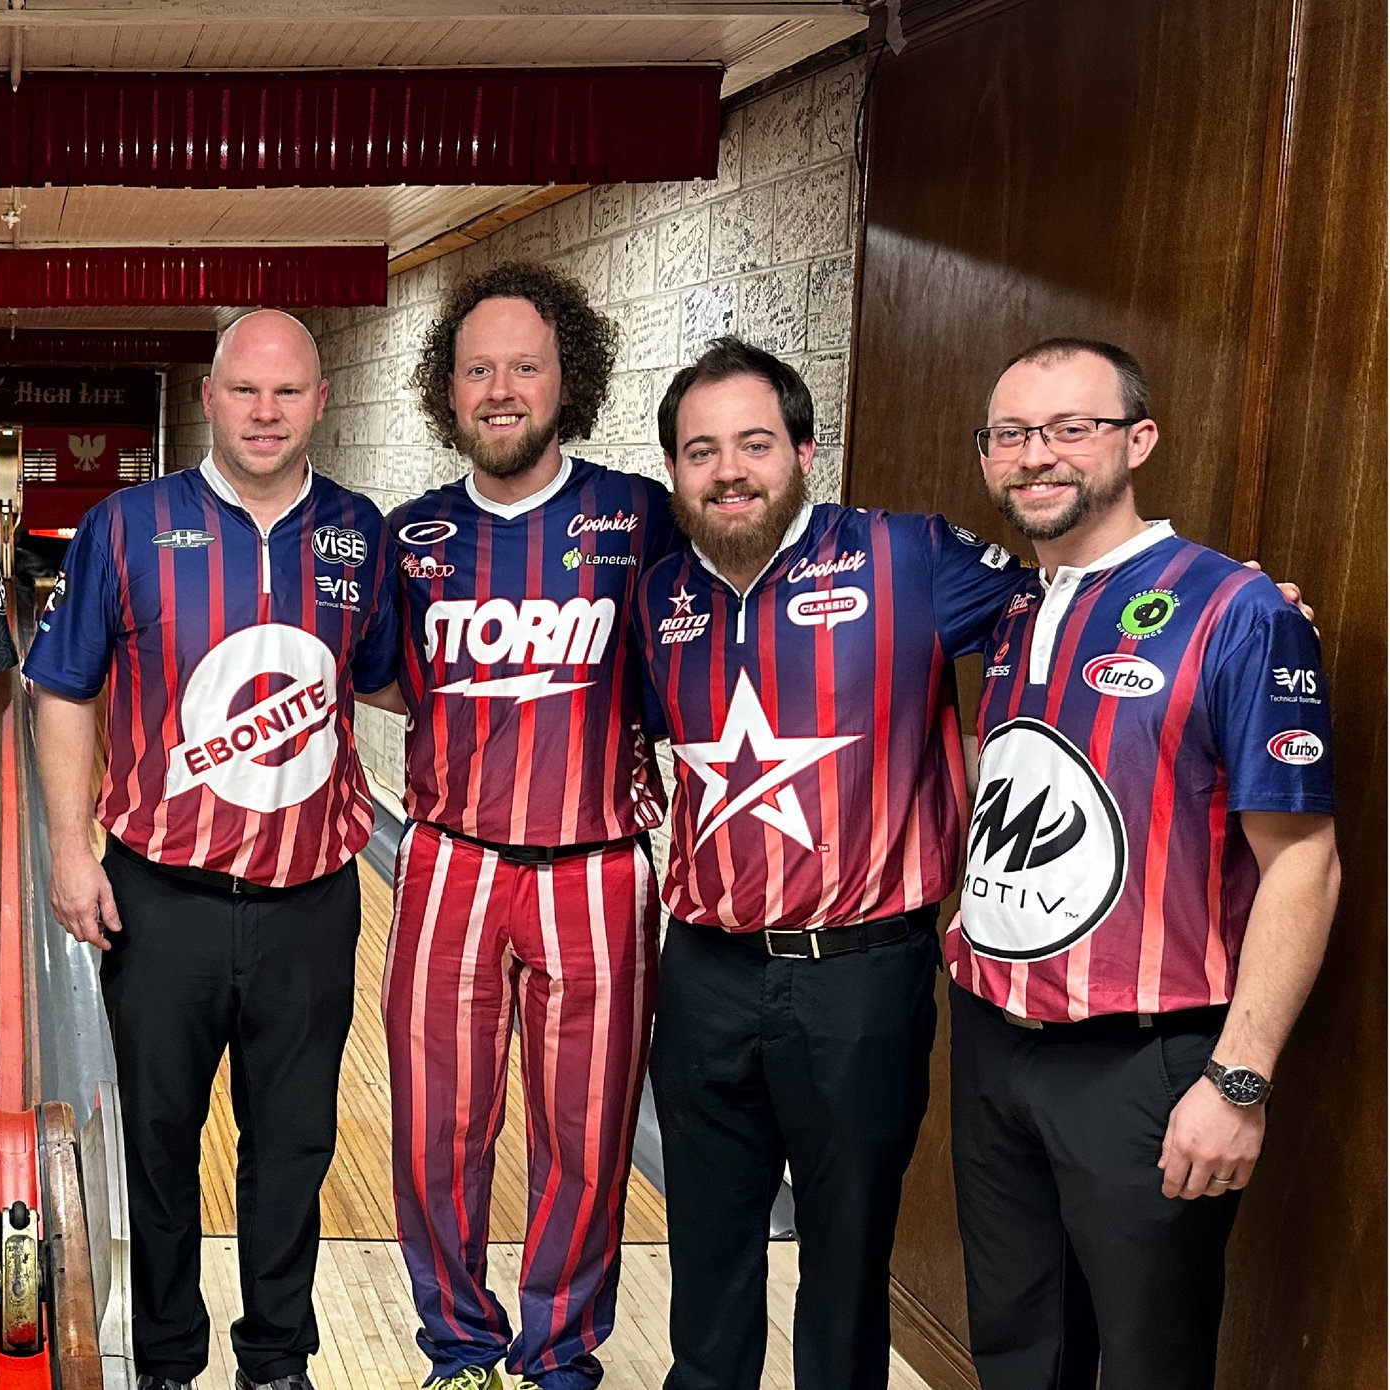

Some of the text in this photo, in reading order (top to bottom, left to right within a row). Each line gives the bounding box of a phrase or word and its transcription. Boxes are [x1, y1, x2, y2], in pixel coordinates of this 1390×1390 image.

[78, 382, 126, 404] LIFE
[567, 511, 639, 537] Coolwick
[585, 553, 638, 566] Lanetalk
[787, 550, 866, 583] Coolwick
[317, 575, 360, 603] VIS
[799, 599, 855, 614] CLASSIC
[424, 598, 616, 665] STORM
[658, 613, 711, 632] ROTO
[661, 627, 706, 645] GRIP
[1098, 666, 1154, 690] Turbo
[1274, 668, 1317, 695] VIS
[184, 679, 327, 776] EBONITE
[1282, 741, 1319, 757] Turbo
